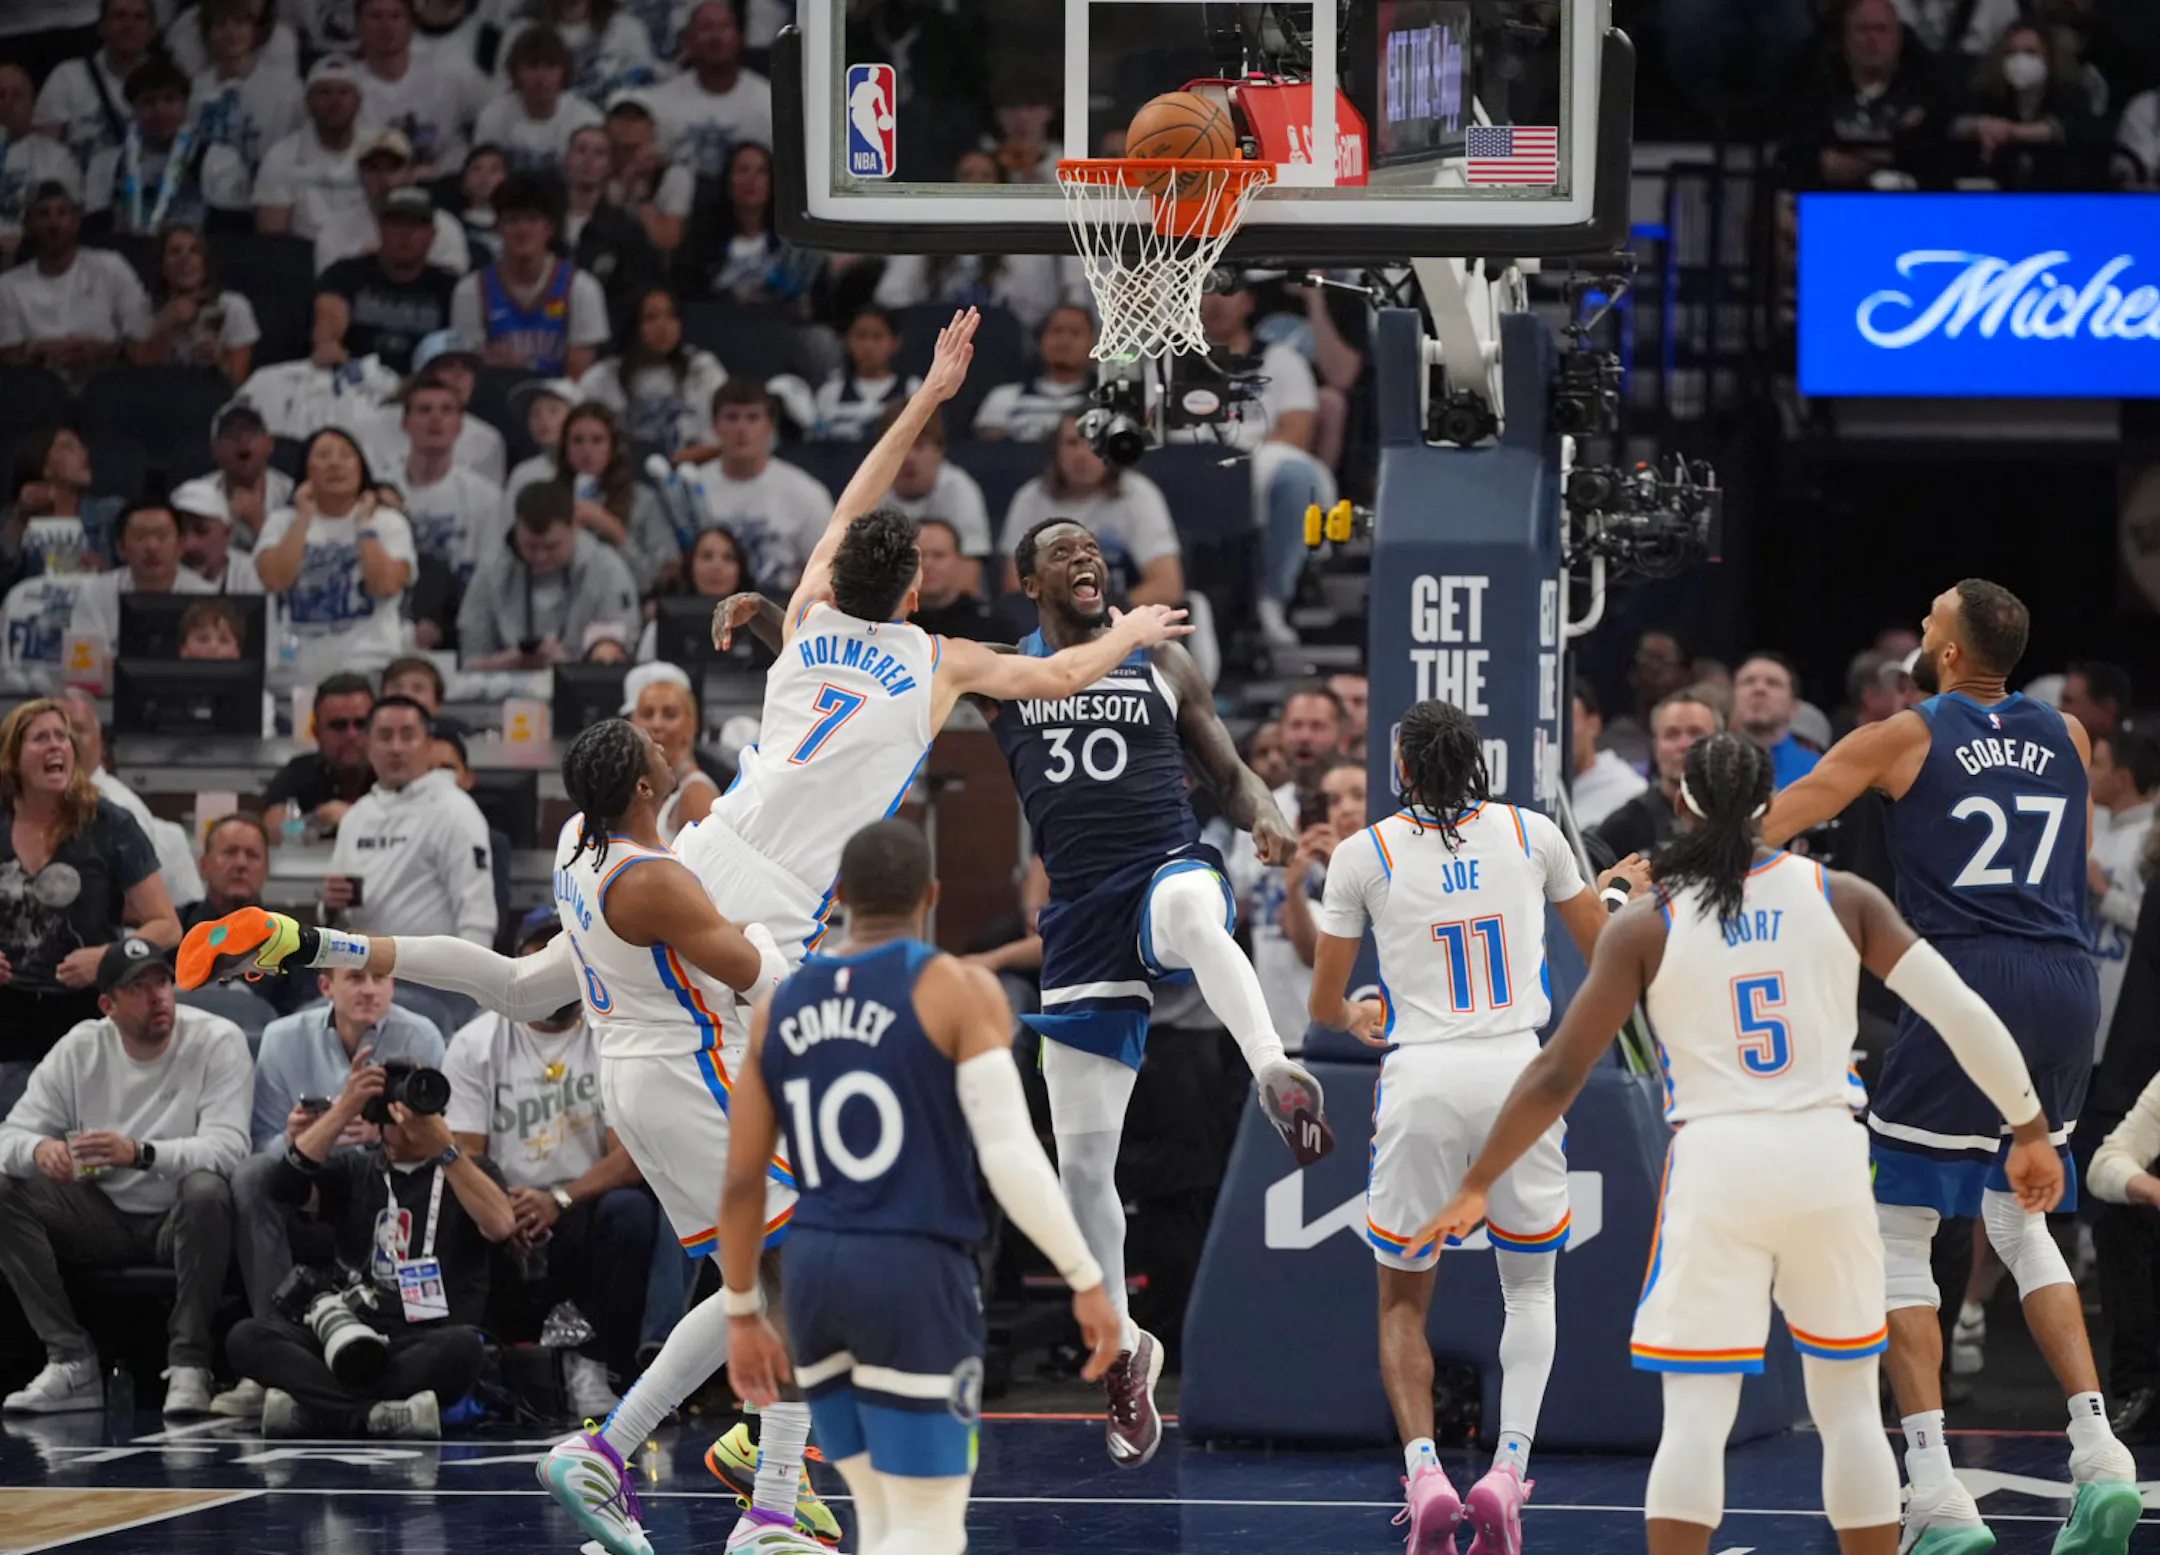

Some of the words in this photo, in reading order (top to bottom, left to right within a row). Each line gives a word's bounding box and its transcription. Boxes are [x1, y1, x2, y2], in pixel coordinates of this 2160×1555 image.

[853, 152, 877, 170] NBA
[1856, 249, 2160, 349] Miche
[1411, 574, 1489, 643] GET
[799, 635, 916, 697] HOLMGREN
[1409, 649, 1489, 717] THE
[787, 682, 867, 765] 7
[1017, 695, 1149, 726] MINNESOTA
[1042, 727, 1128, 783] 30
[1955, 737, 2055, 776] GOBERT
[1949, 794, 2068, 887] 27
[1441, 859, 1479, 894] JOE
[1431, 913, 1513, 1012] 11
[779, 997, 897, 1056] CONLEY
[1730, 970, 1794, 1079] 5
[783, 1070, 904, 1188] 10
